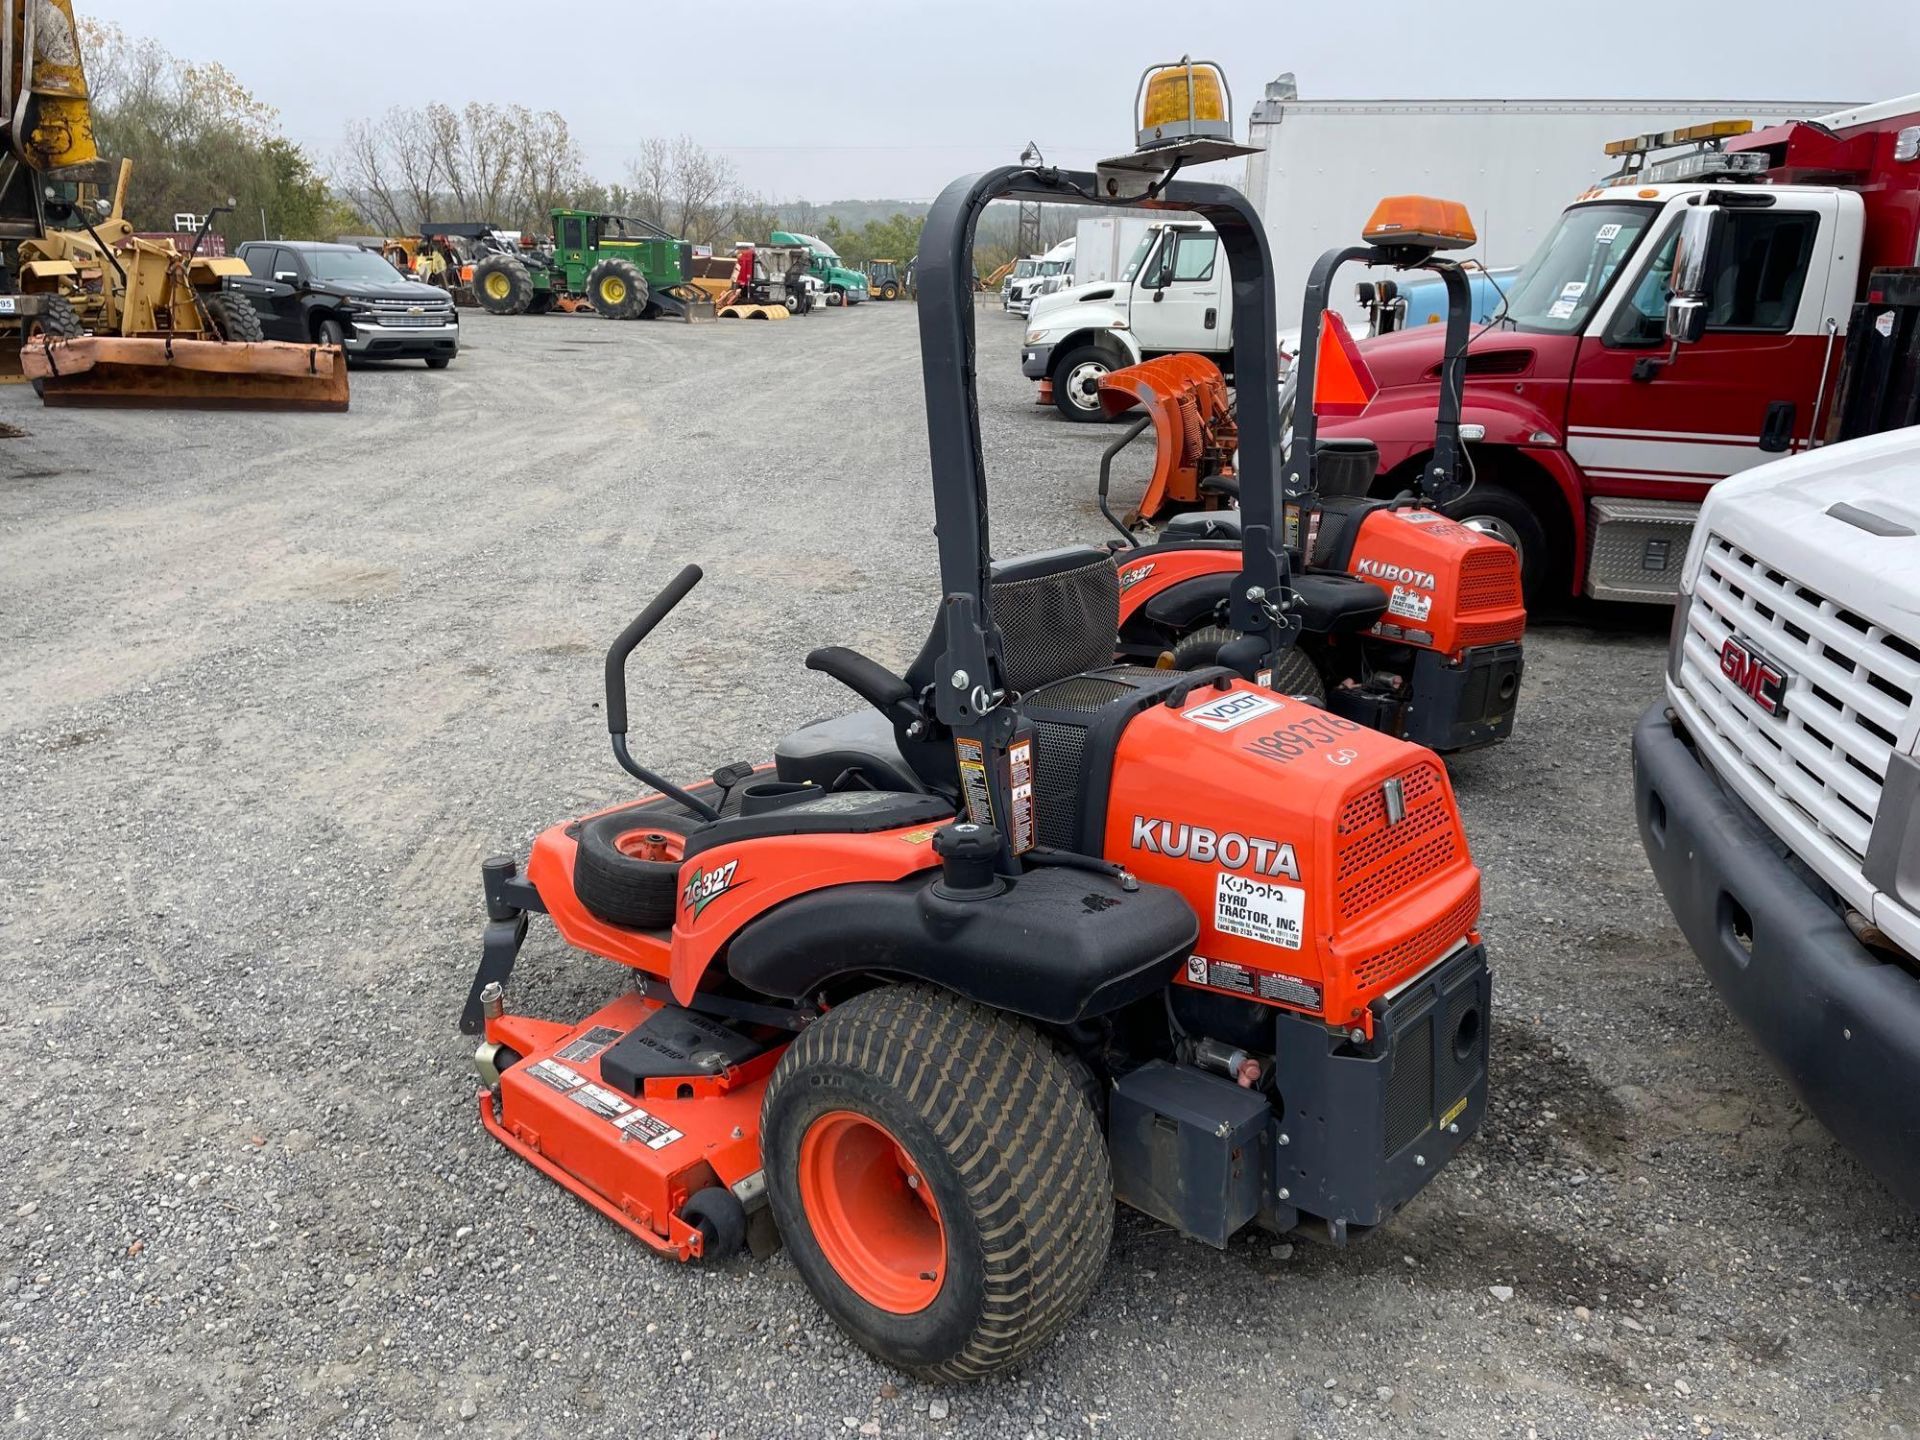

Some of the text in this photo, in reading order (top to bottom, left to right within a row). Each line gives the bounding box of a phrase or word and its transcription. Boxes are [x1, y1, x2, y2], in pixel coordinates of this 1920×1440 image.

[1357, 558, 1436, 592] KUBOTA
[1720, 637, 1782, 715] GMC
[1203, 694, 1263, 719] VDOT
[1242, 714, 1361, 765] N89376
[1131, 814, 1303, 883] KUBOTA
[683, 858, 739, 908] ZG327
[1220, 874, 1284, 902] Kubota
[1219, 892, 1248, 908] BYRD
[1218, 903, 1272, 928] TRACTOR,
[1276, 916, 1300, 933] INC.
[1220, 961, 1243, 970] DANGER
[1277, 973, 1304, 985] PELIGRO
